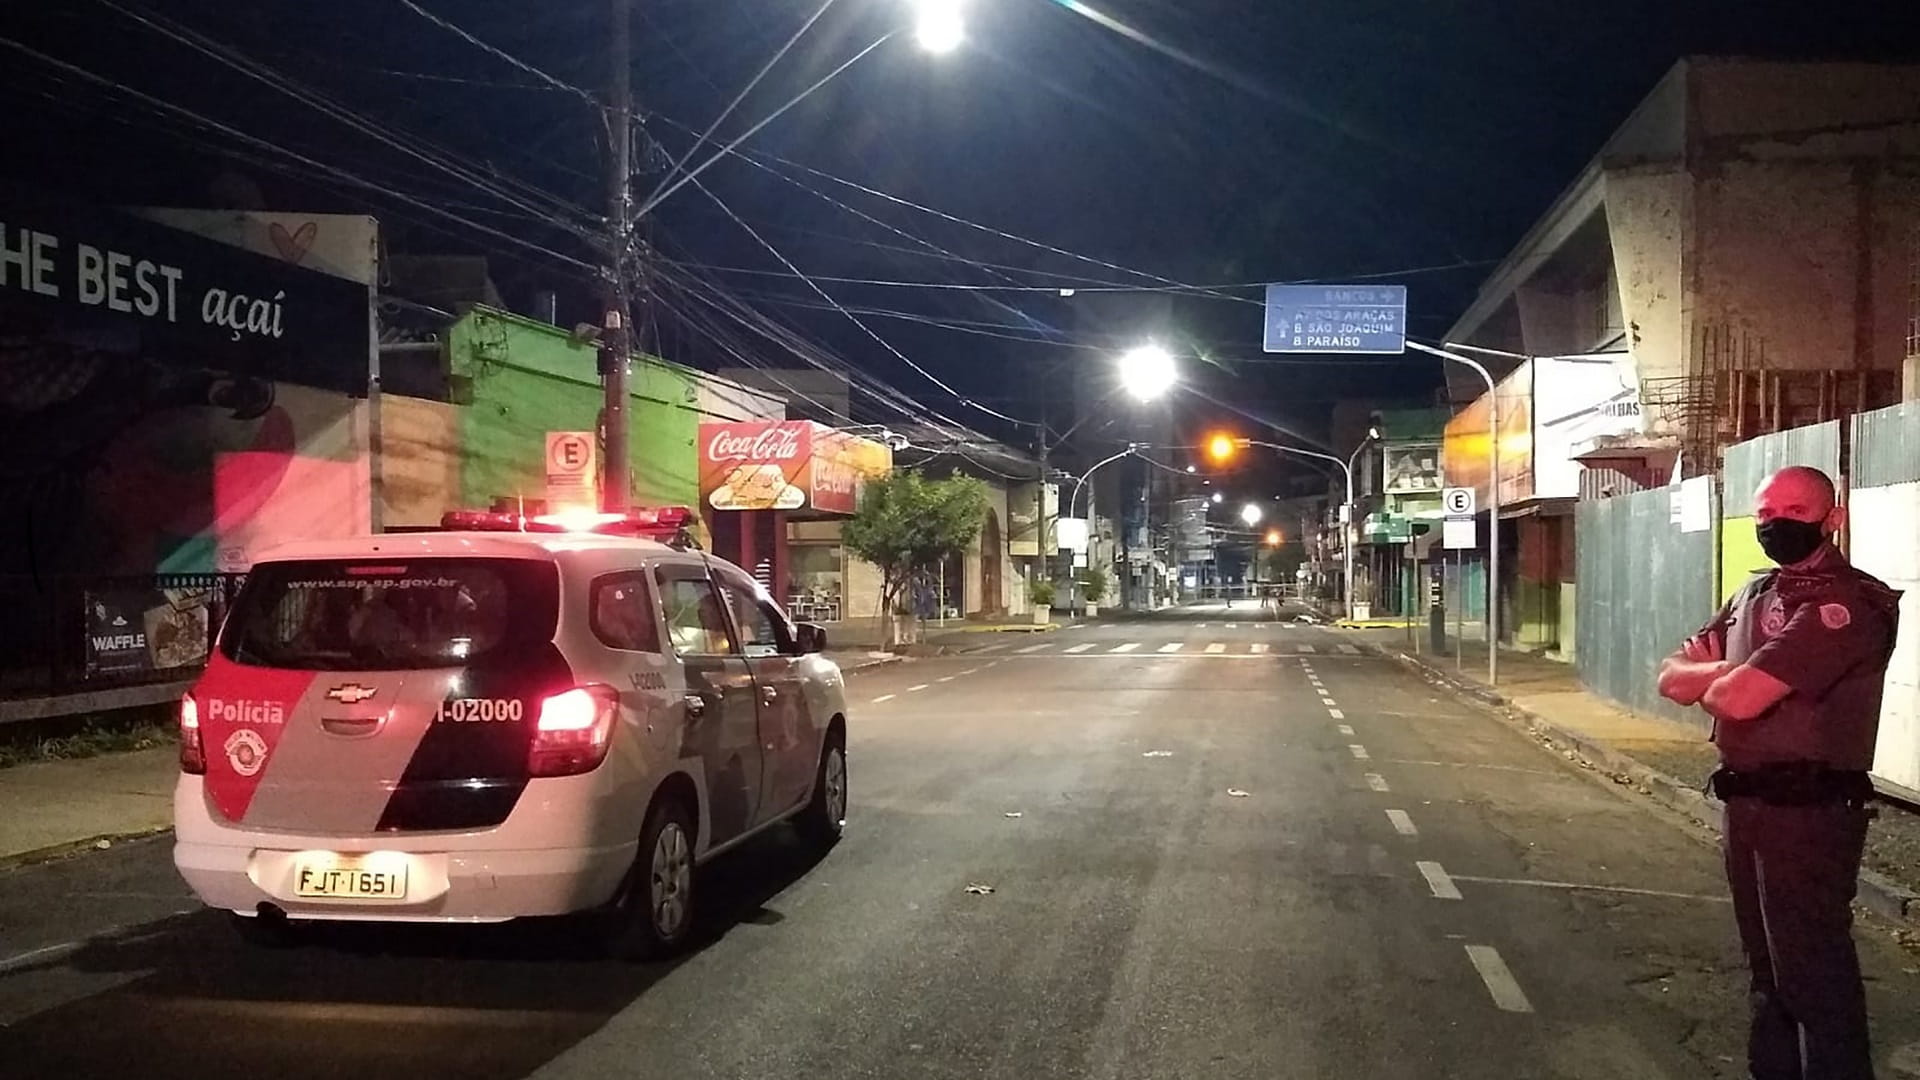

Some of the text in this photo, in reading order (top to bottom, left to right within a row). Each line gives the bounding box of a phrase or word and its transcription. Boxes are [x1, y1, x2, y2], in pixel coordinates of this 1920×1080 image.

[78, 243, 183, 322] BEST
[202, 288, 285, 341] açaí
[1307, 333, 1360, 347] PARAÍSO
[564, 443, 579, 464] E
[1455, 494, 1464, 508] E
[287, 576, 458, 590] www.ssp.sp.gov.br
[93, 633, 146, 651] WAFFLE
[208, 698, 284, 724] Polícia
